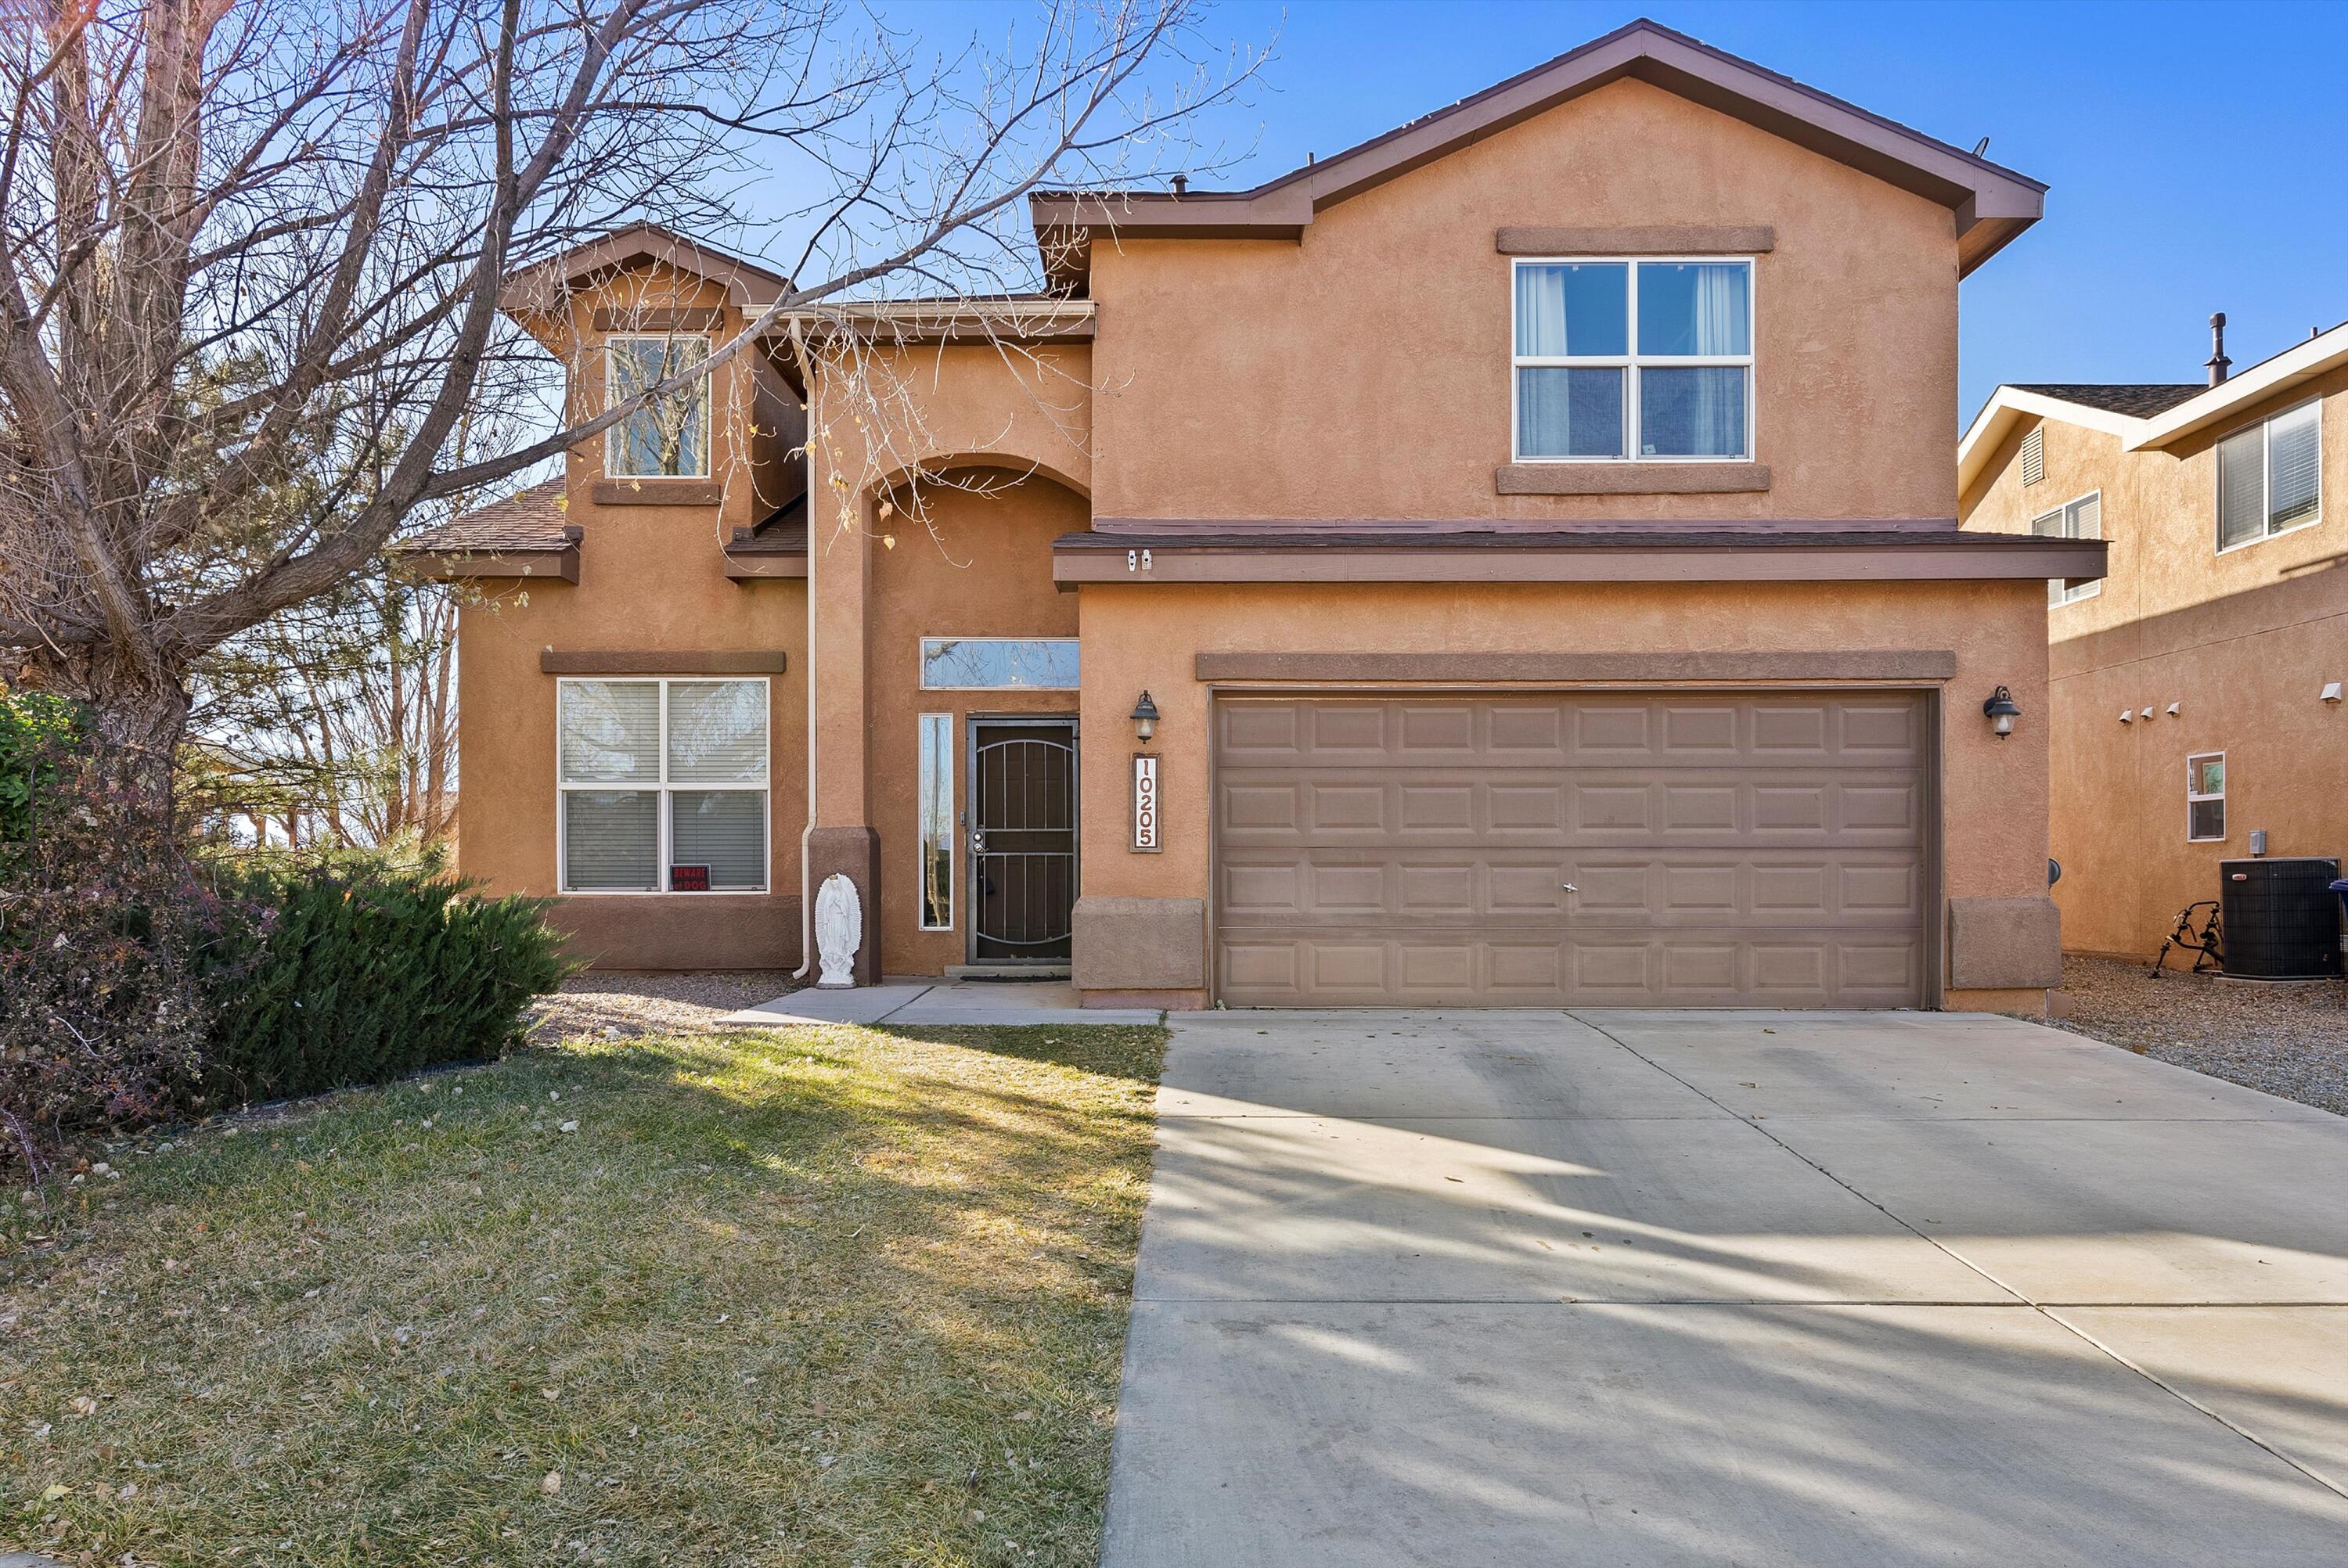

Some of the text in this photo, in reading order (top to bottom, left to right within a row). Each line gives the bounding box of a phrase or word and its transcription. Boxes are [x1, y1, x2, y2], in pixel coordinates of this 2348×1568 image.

[1140, 760, 1153, 845] 10205
[675, 869, 706, 877] BEWARE
[684, 881, 707, 890] DOG
